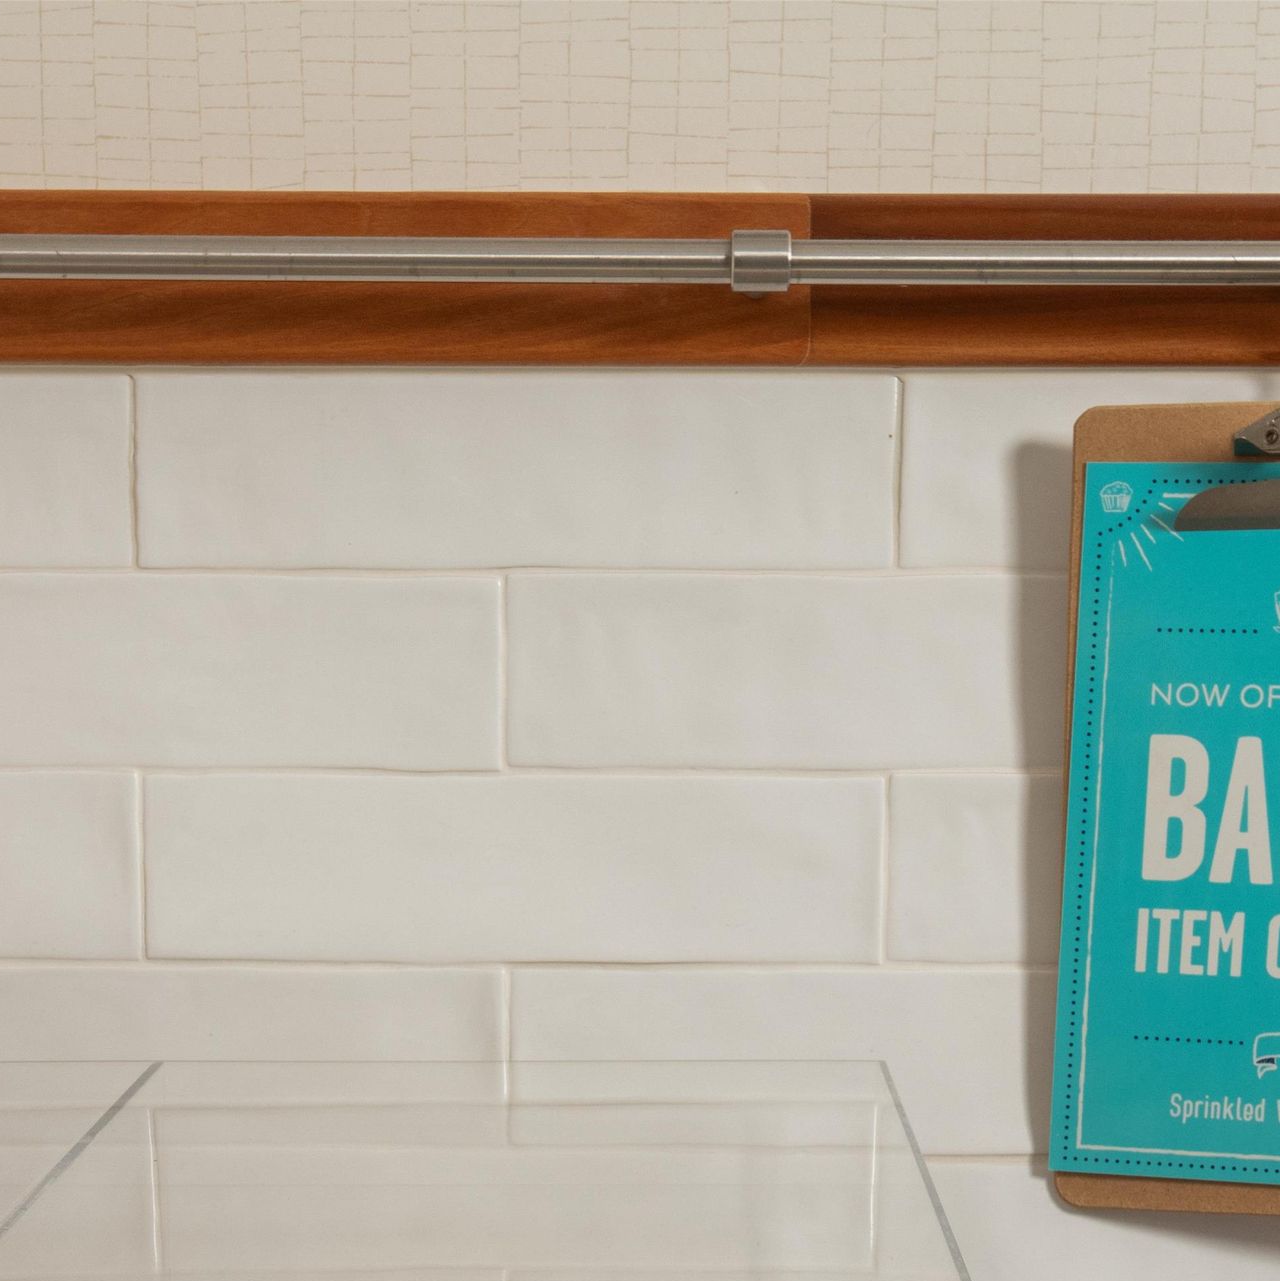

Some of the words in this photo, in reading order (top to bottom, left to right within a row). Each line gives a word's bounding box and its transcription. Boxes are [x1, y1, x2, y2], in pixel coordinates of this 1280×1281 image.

[1151, 683, 1230, 707] NOW
[1134, 908, 1245, 977] ITEM
[1169, 1093, 1266, 1123] Sprinkled
